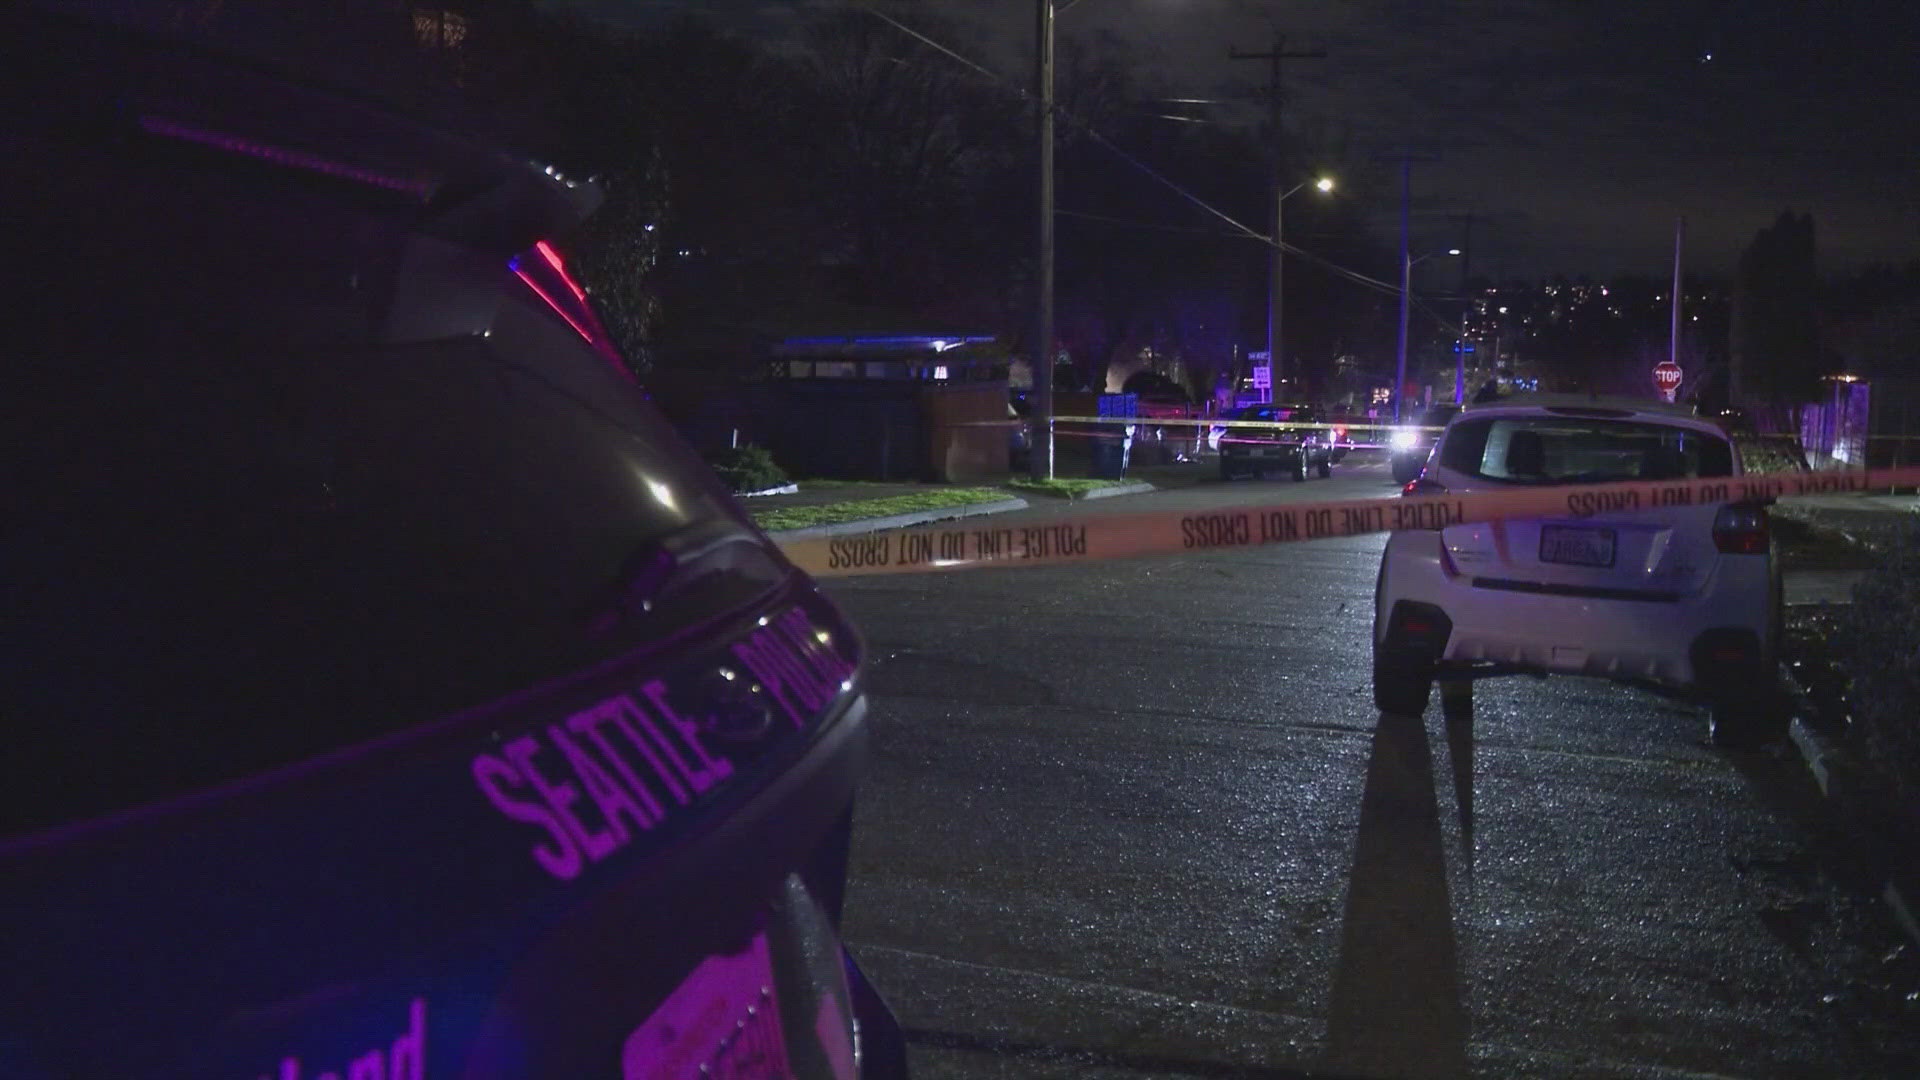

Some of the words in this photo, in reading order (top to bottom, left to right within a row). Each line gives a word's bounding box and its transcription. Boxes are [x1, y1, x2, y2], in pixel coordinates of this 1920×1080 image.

[1655, 370, 1680, 382] STOP
[1182, 514, 1249, 549] CROSS
[1260, 511, 1297, 543] NOT
[1306, 510, 1332, 539] DO
[1340, 506, 1384, 535] LINE
[1391, 502, 1464, 531] POLICE
[828, 536, 889, 569] CROSS
[897, 533, 935, 565] NOT
[941, 532, 965, 561] DO
[972, 528, 1013, 560] LINE
[1020, 525, 1087, 560] POLICE
[471, 679, 735, 881] SEATTLE
[729, 606, 858, 730] POLIC
